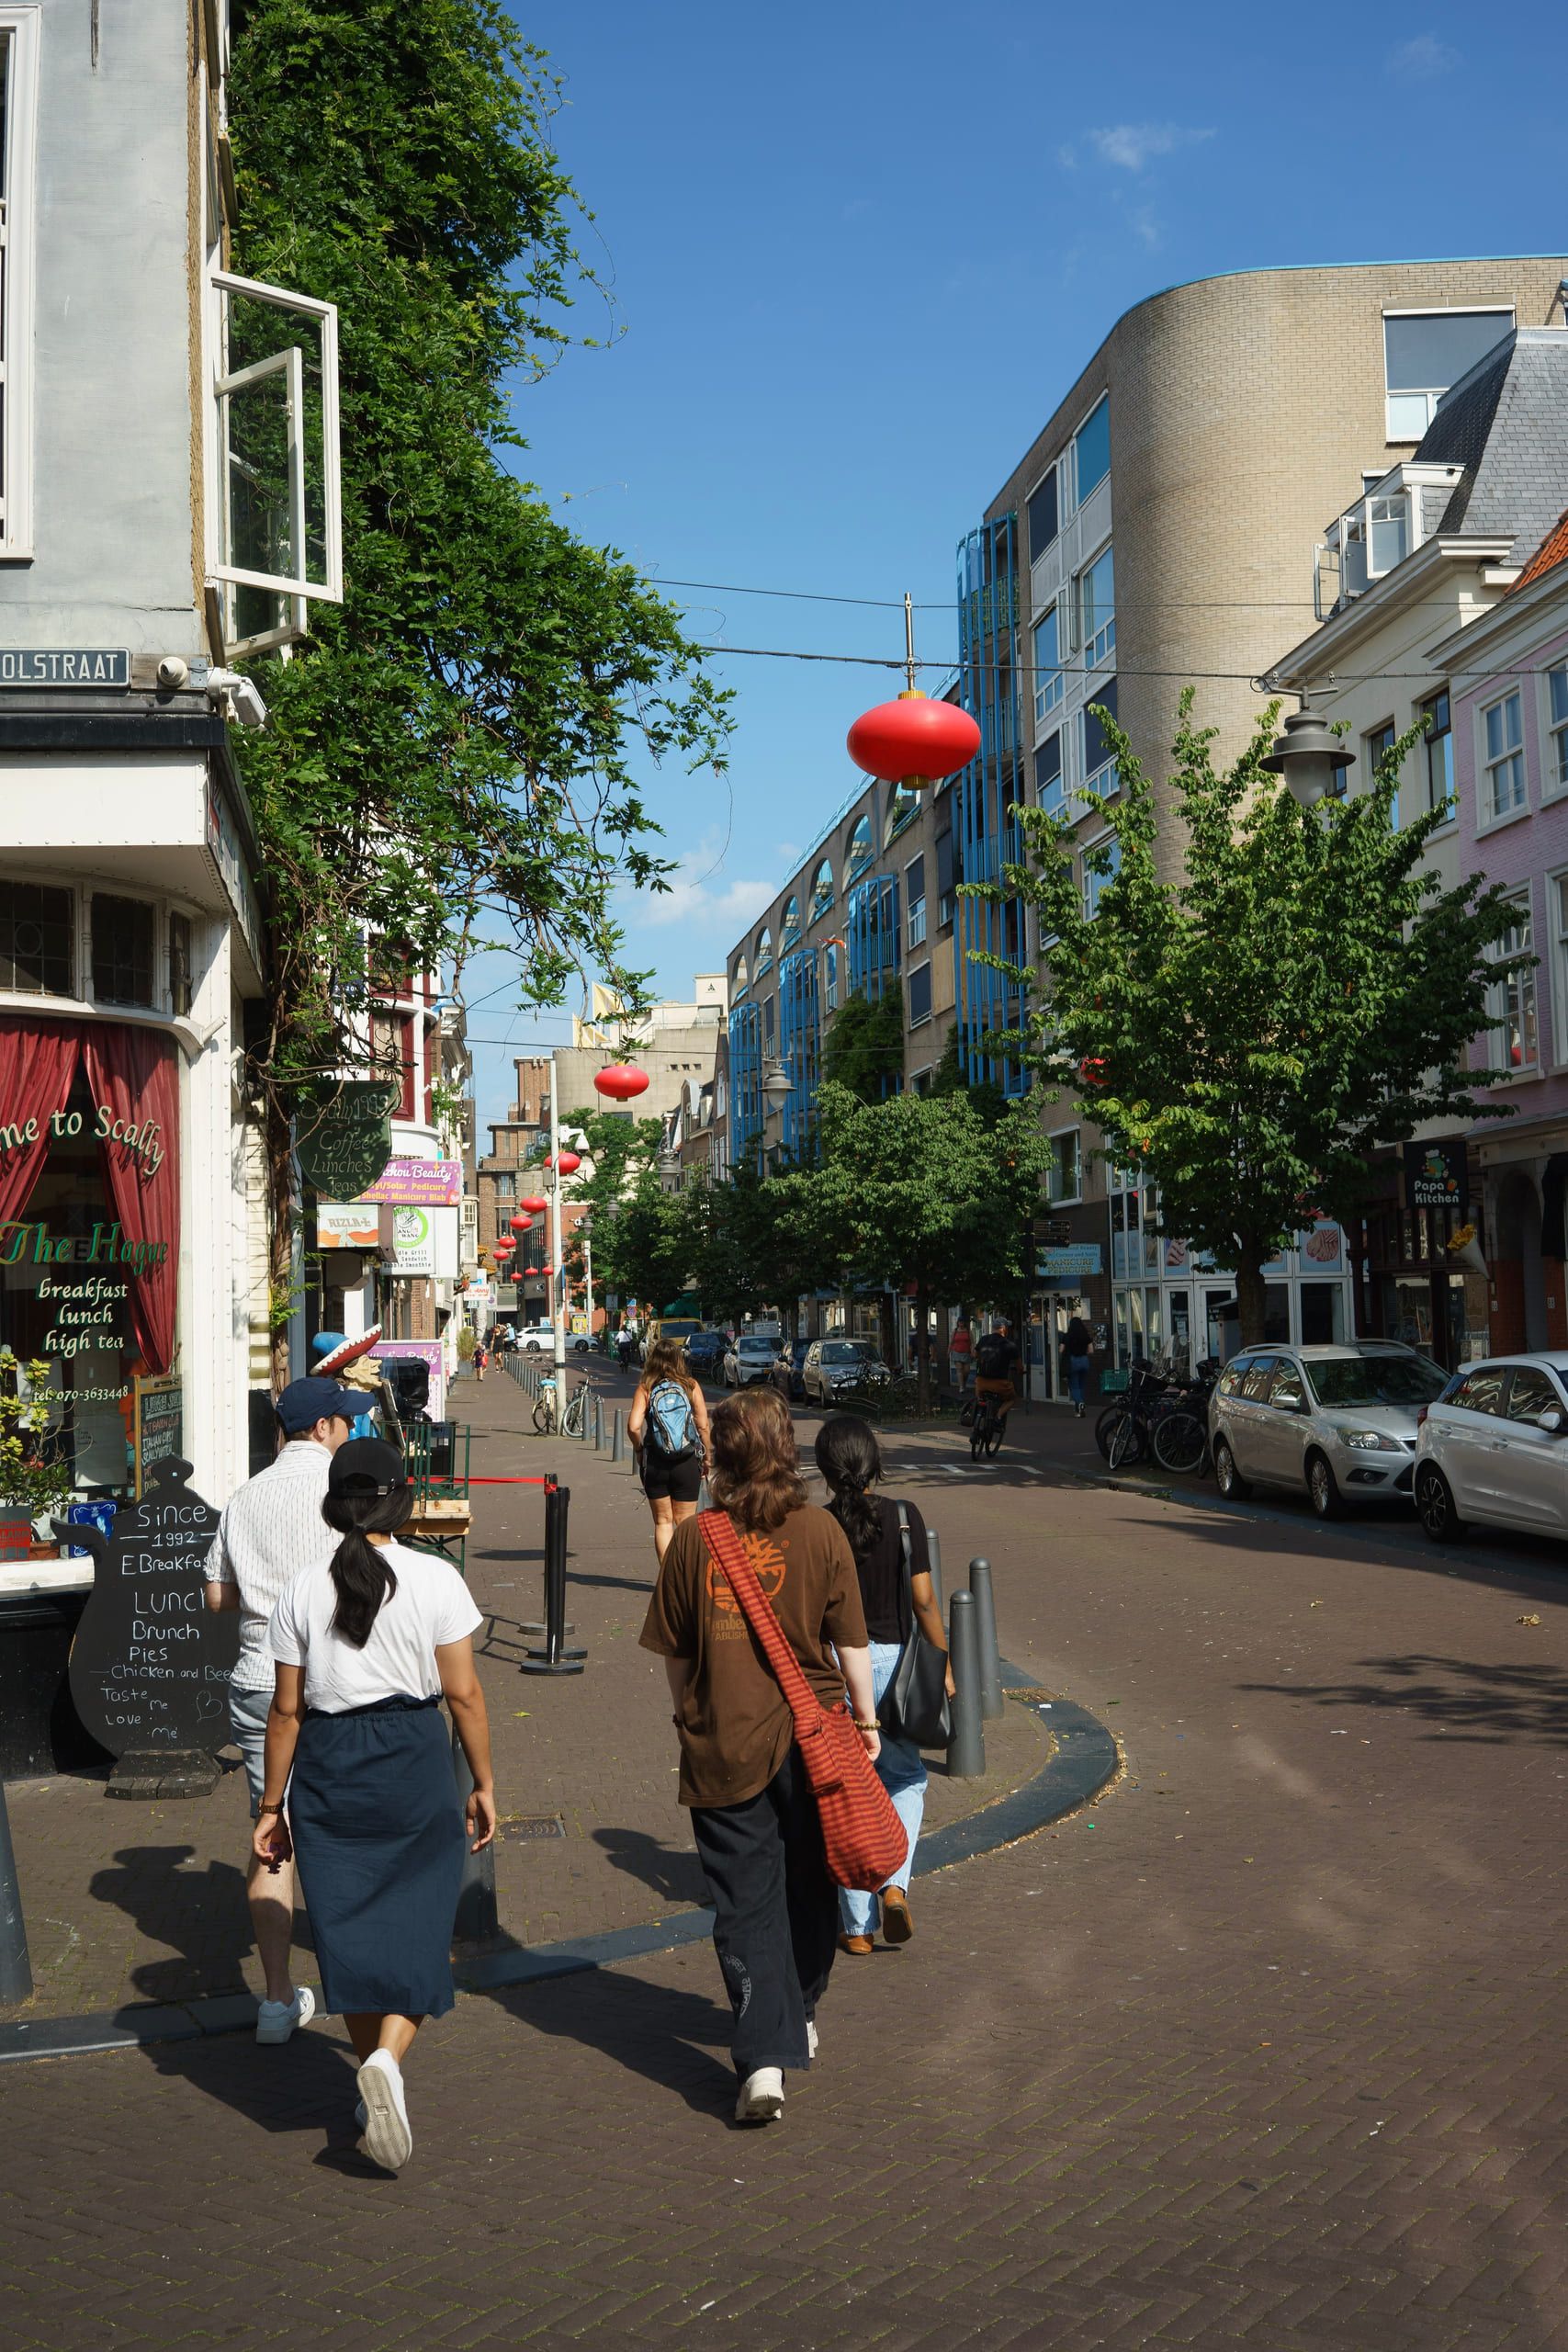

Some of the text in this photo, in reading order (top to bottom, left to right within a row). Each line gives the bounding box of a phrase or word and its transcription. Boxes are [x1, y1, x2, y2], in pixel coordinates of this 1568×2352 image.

[2, 653, 118, 680] OLSTRAAT
[51, 1109, 83, 1136] to
[95, 1105, 164, 1175] Scally
[320, 1130, 369, 1158] Coffee
[311, 1154, 372, 1174] Lunches
[412, 1165, 451, 1182] Beauty
[327, 1176, 357, 1193] Teas
[1415, 1180, 1445, 1193] Papa
[391, 1193, 426, 1201] Manicure
[1415, 1193, 1460, 1204] Kitchen
[0, 1220, 74, 1265] The
[87, 1222, 169, 1276] Hague
[39, 1277, 129, 1306] breakfast
[59, 1303, 113, 1324] lunch
[45, 1329, 125, 1358] high tea
[56, 1385, 129, 1402] 070-3633448
[138, 1504, 208, 1527] Since
[152, 1532, 197, 1547] 1992
[121, 1554, 203, 1575] E Breakfa
[132, 1620, 200, 1640] Brunch
[129, 1646, 168, 1663] Pies
[111, 1664, 231, 1681] Chicken and Bee
[100, 1688, 148, 1702] Taste
[105, 1714, 141, 1725] Love
